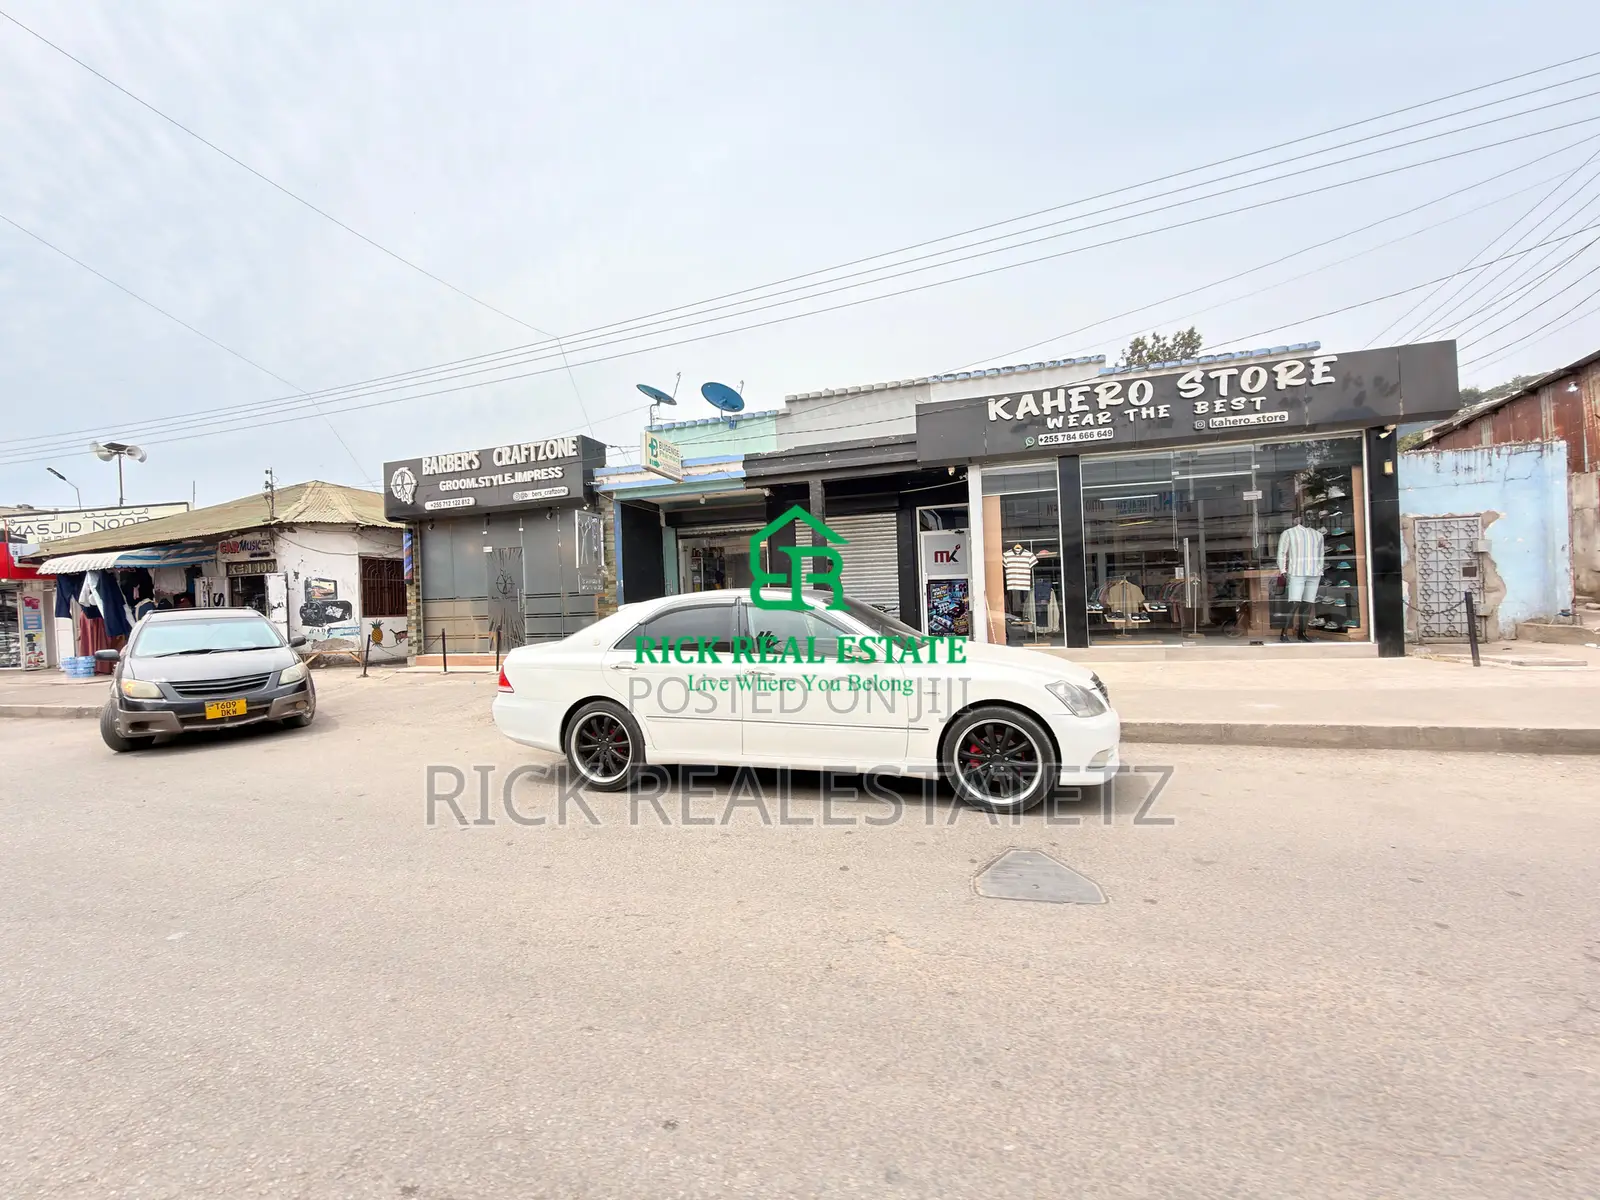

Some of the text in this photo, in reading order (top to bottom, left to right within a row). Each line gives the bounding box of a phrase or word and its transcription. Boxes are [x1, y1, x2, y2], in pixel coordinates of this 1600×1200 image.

[988, 355, 1338, 421] KAHERO STORE
[1046, 396, 1267, 429] WEAR THE BEST
[1210, 412, 1286, 427] kahero_store
[1039, 429, 1113, 443] +255 784 666 649
[422, 436, 578, 476] BARBER'S CRAFTZONE
[8, 521, 82, 535] MASJID
[220, 541, 240, 554] CAR
[215, 701, 237, 709] T609
